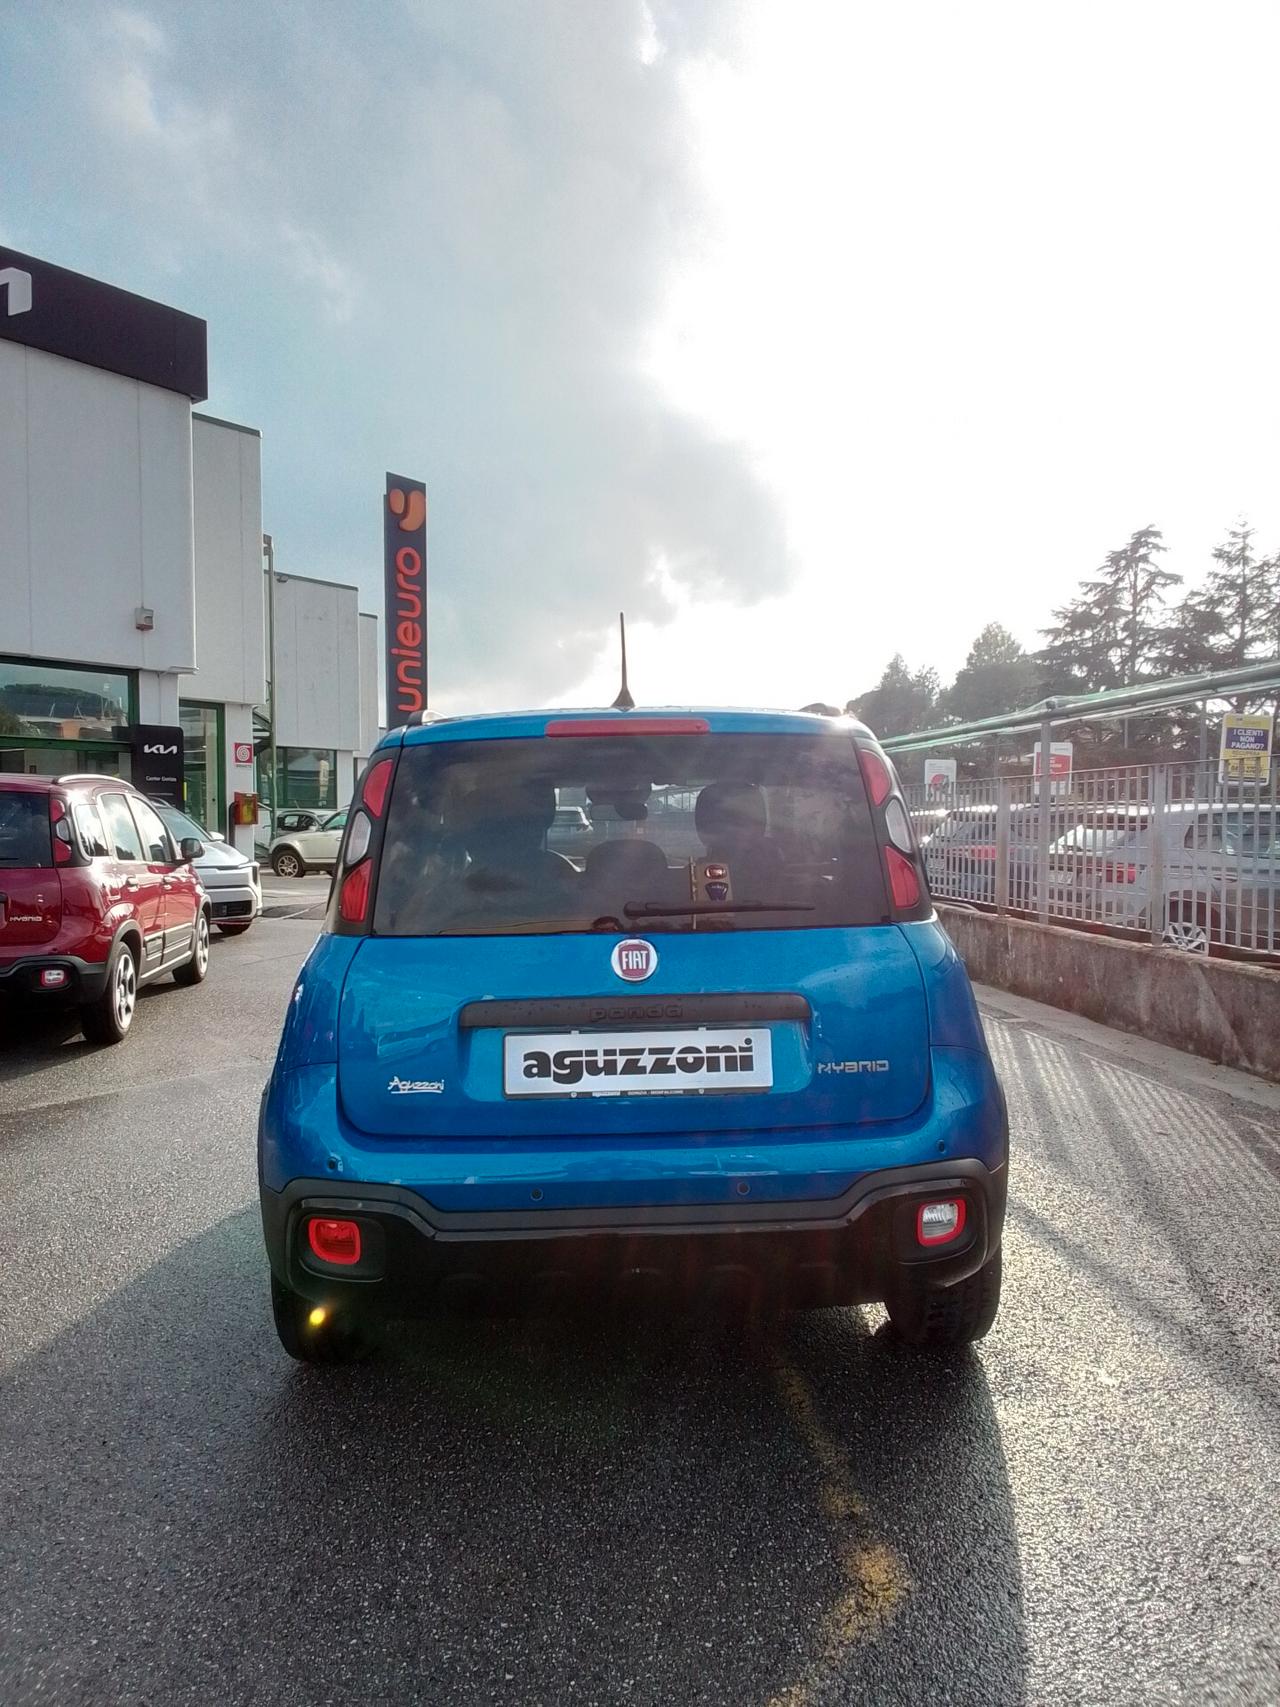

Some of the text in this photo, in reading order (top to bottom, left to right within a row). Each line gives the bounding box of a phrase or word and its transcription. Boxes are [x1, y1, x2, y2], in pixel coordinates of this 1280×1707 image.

[390, 546, 422, 712] unieuro
[1238, 729, 1264, 737] CLIENTI
[1231, 742, 1265, 750] PAGANO?
[621, 950, 648, 970] FIAT
[522, 1037, 755, 1085] aguzzoni
[817, 1059, 890, 1074] HYBRID
[387, 1075, 445, 1094] Aguzzoni
